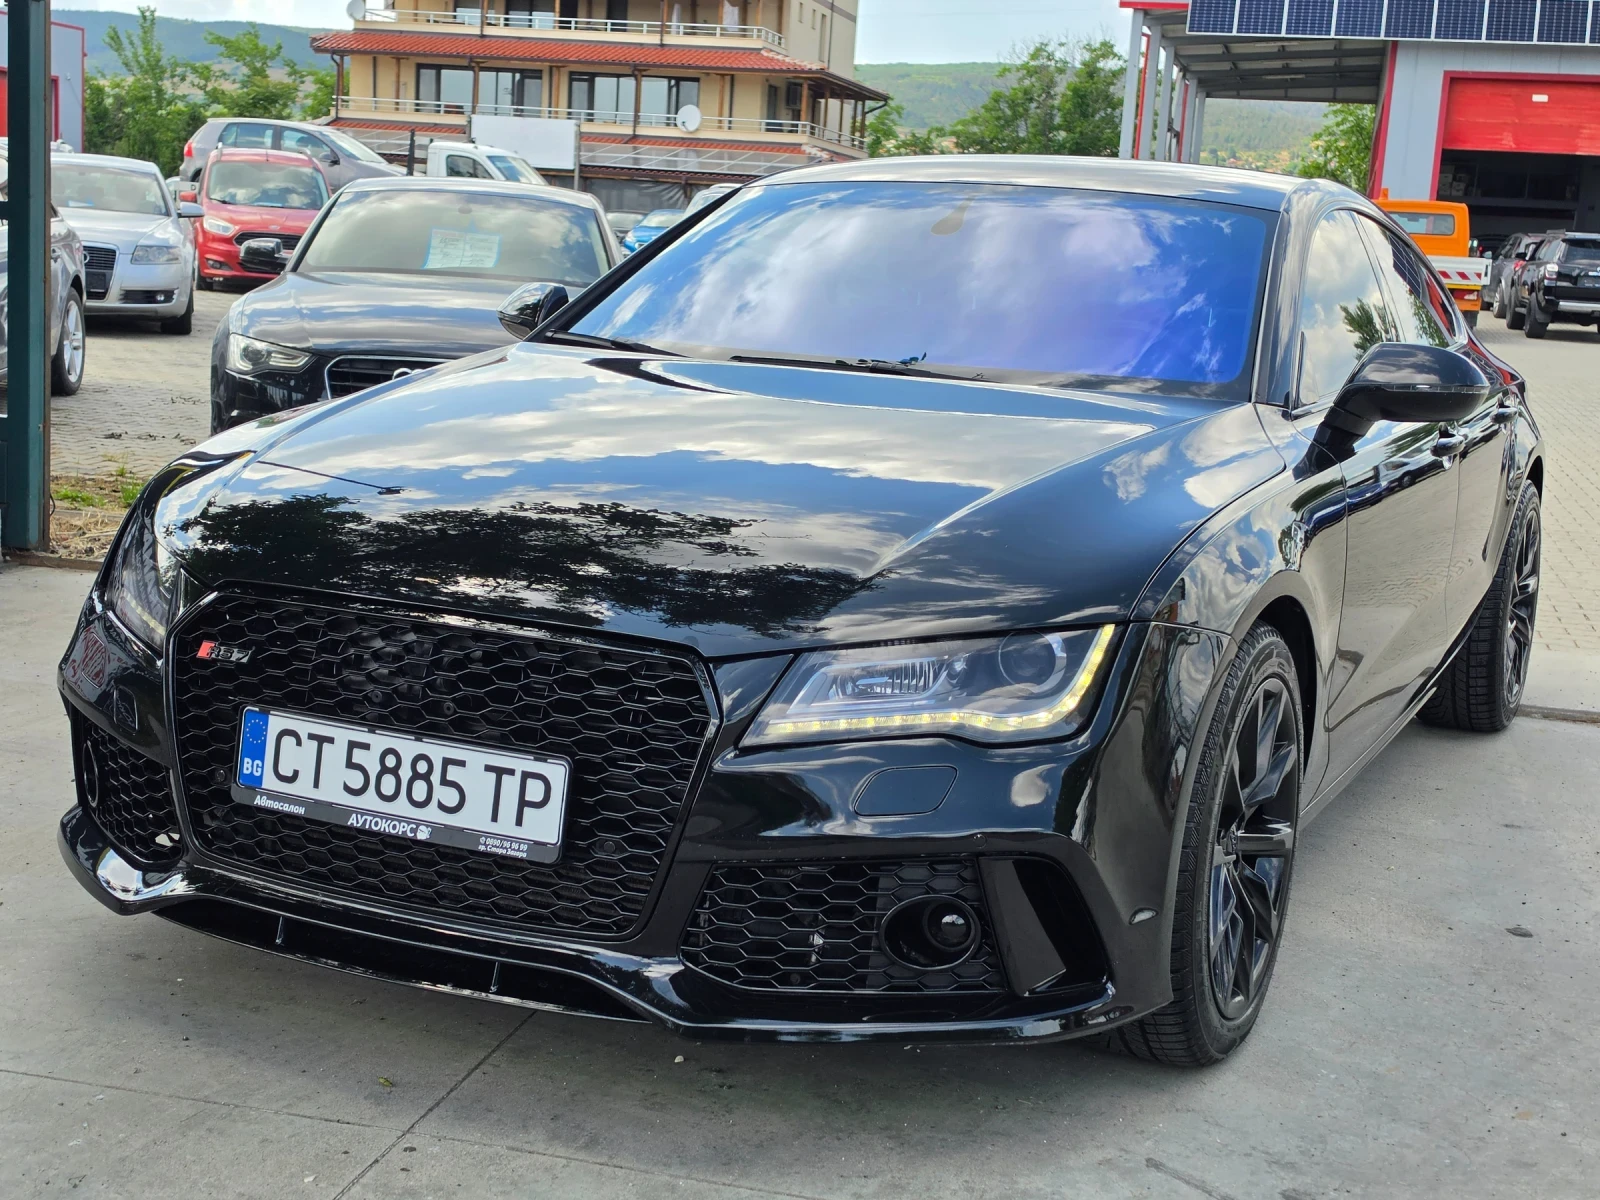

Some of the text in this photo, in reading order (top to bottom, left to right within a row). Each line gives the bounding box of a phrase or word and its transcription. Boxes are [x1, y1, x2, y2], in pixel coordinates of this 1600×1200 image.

[206, 644, 250, 662] RS7
[242, 757, 263, 777] BG
[271, 728, 552, 828] CT 5885 TP
[254, 794, 306, 815] Автосалон
[347, 813, 417, 837] АУТОКОРС
